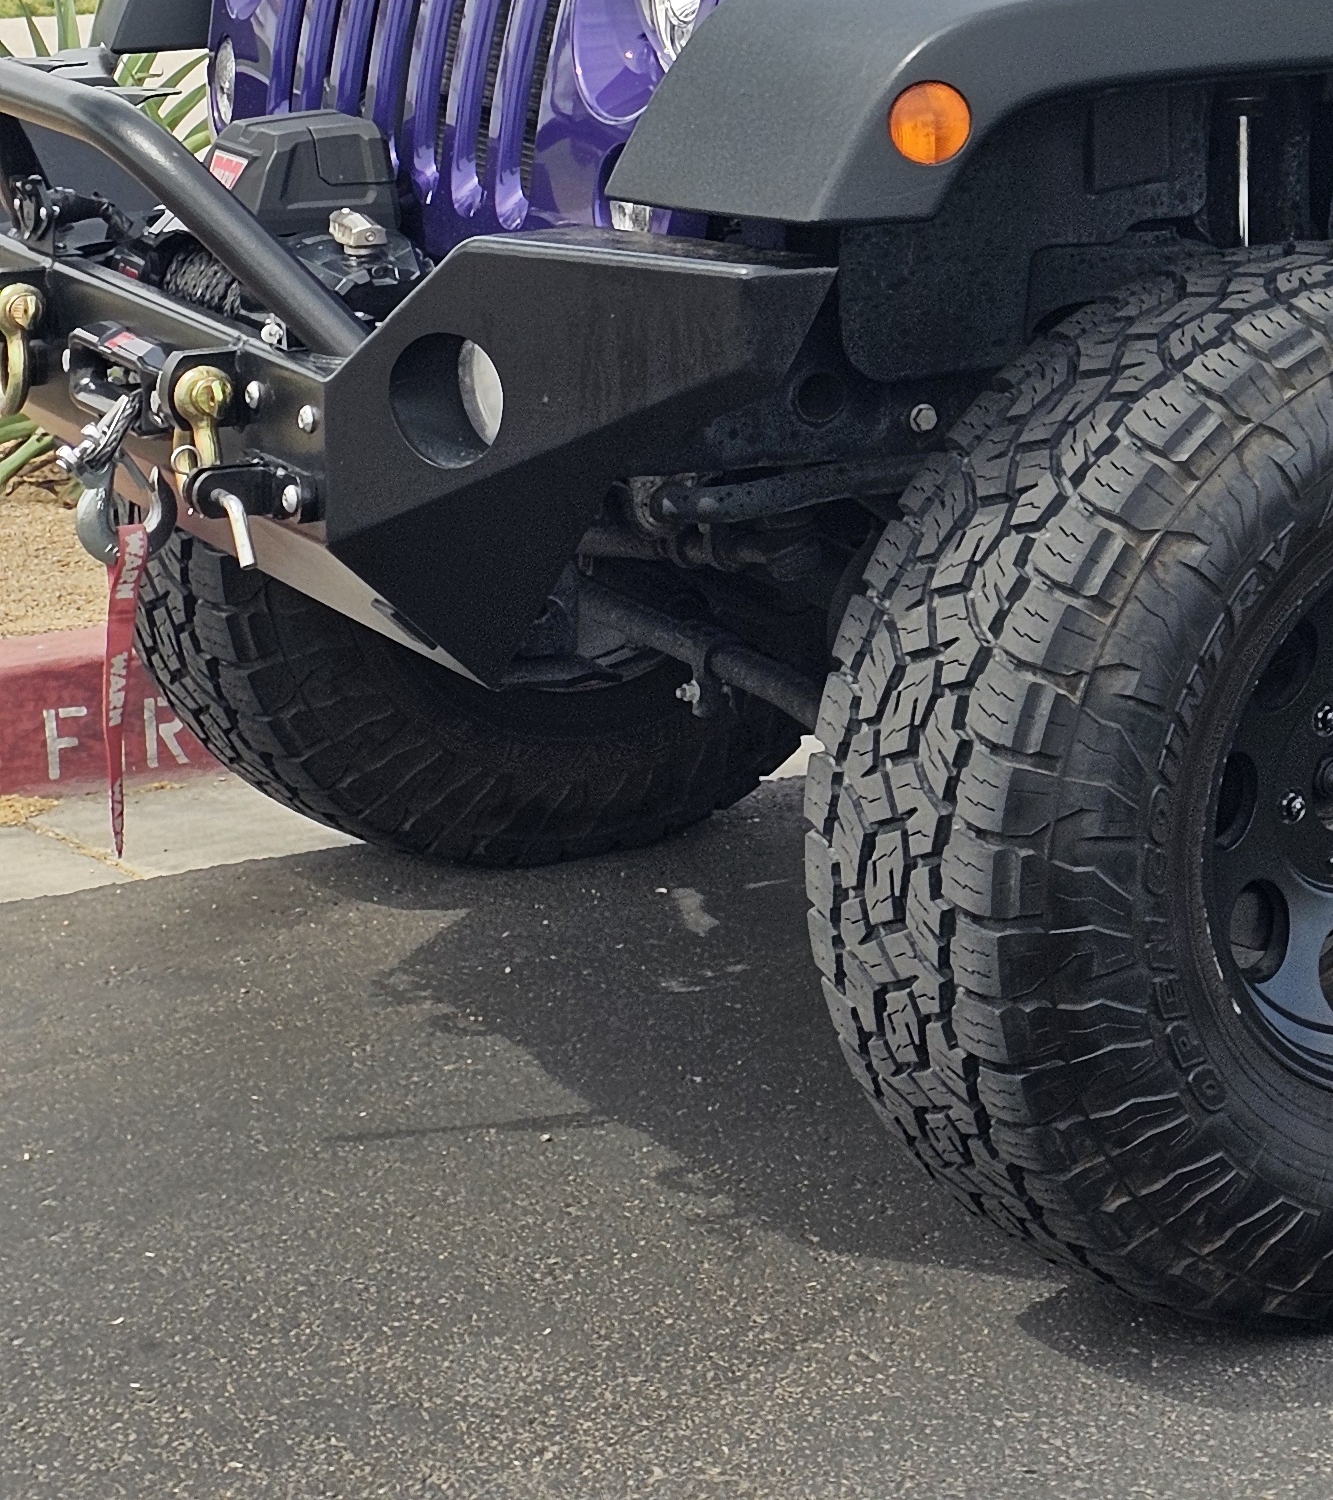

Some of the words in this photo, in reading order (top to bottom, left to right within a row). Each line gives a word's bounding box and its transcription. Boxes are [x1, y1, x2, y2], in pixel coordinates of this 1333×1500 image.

[115, 530, 144, 599] WARN
[108, 651, 128, 727] WARN
[1141, 519, 1299, 897] COUNTRY
[1142, 912, 1230, 1115] OPEN
